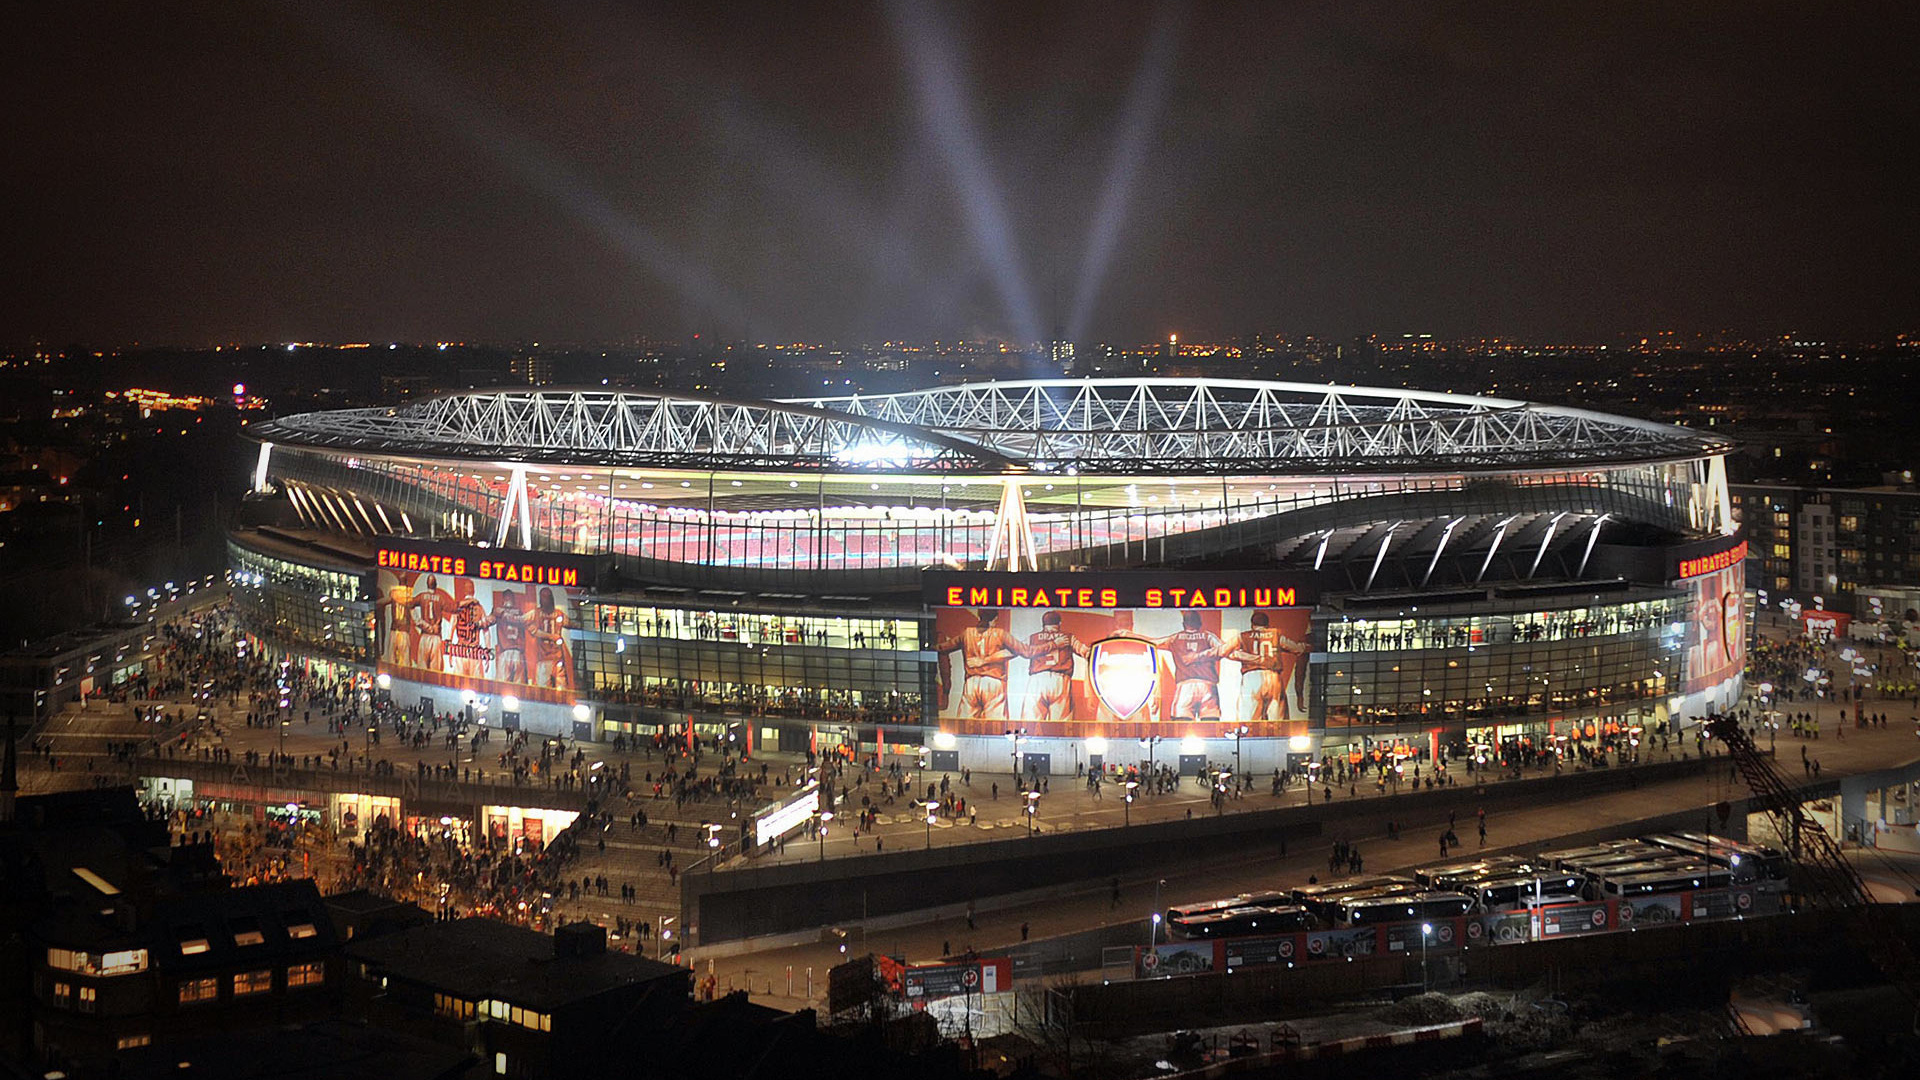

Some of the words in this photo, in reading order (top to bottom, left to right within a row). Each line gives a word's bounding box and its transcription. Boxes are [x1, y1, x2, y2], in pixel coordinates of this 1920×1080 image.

[377, 549, 466, 575] EMIRATES
[479, 560, 578, 586] STADIUM
[1680, 550, 1731, 578] EMIRATES
[947, 586, 1118, 607] EMIRATES
[1145, 587, 1296, 607] STADIUM
[1249, 631, 1273, 640] JAMES
